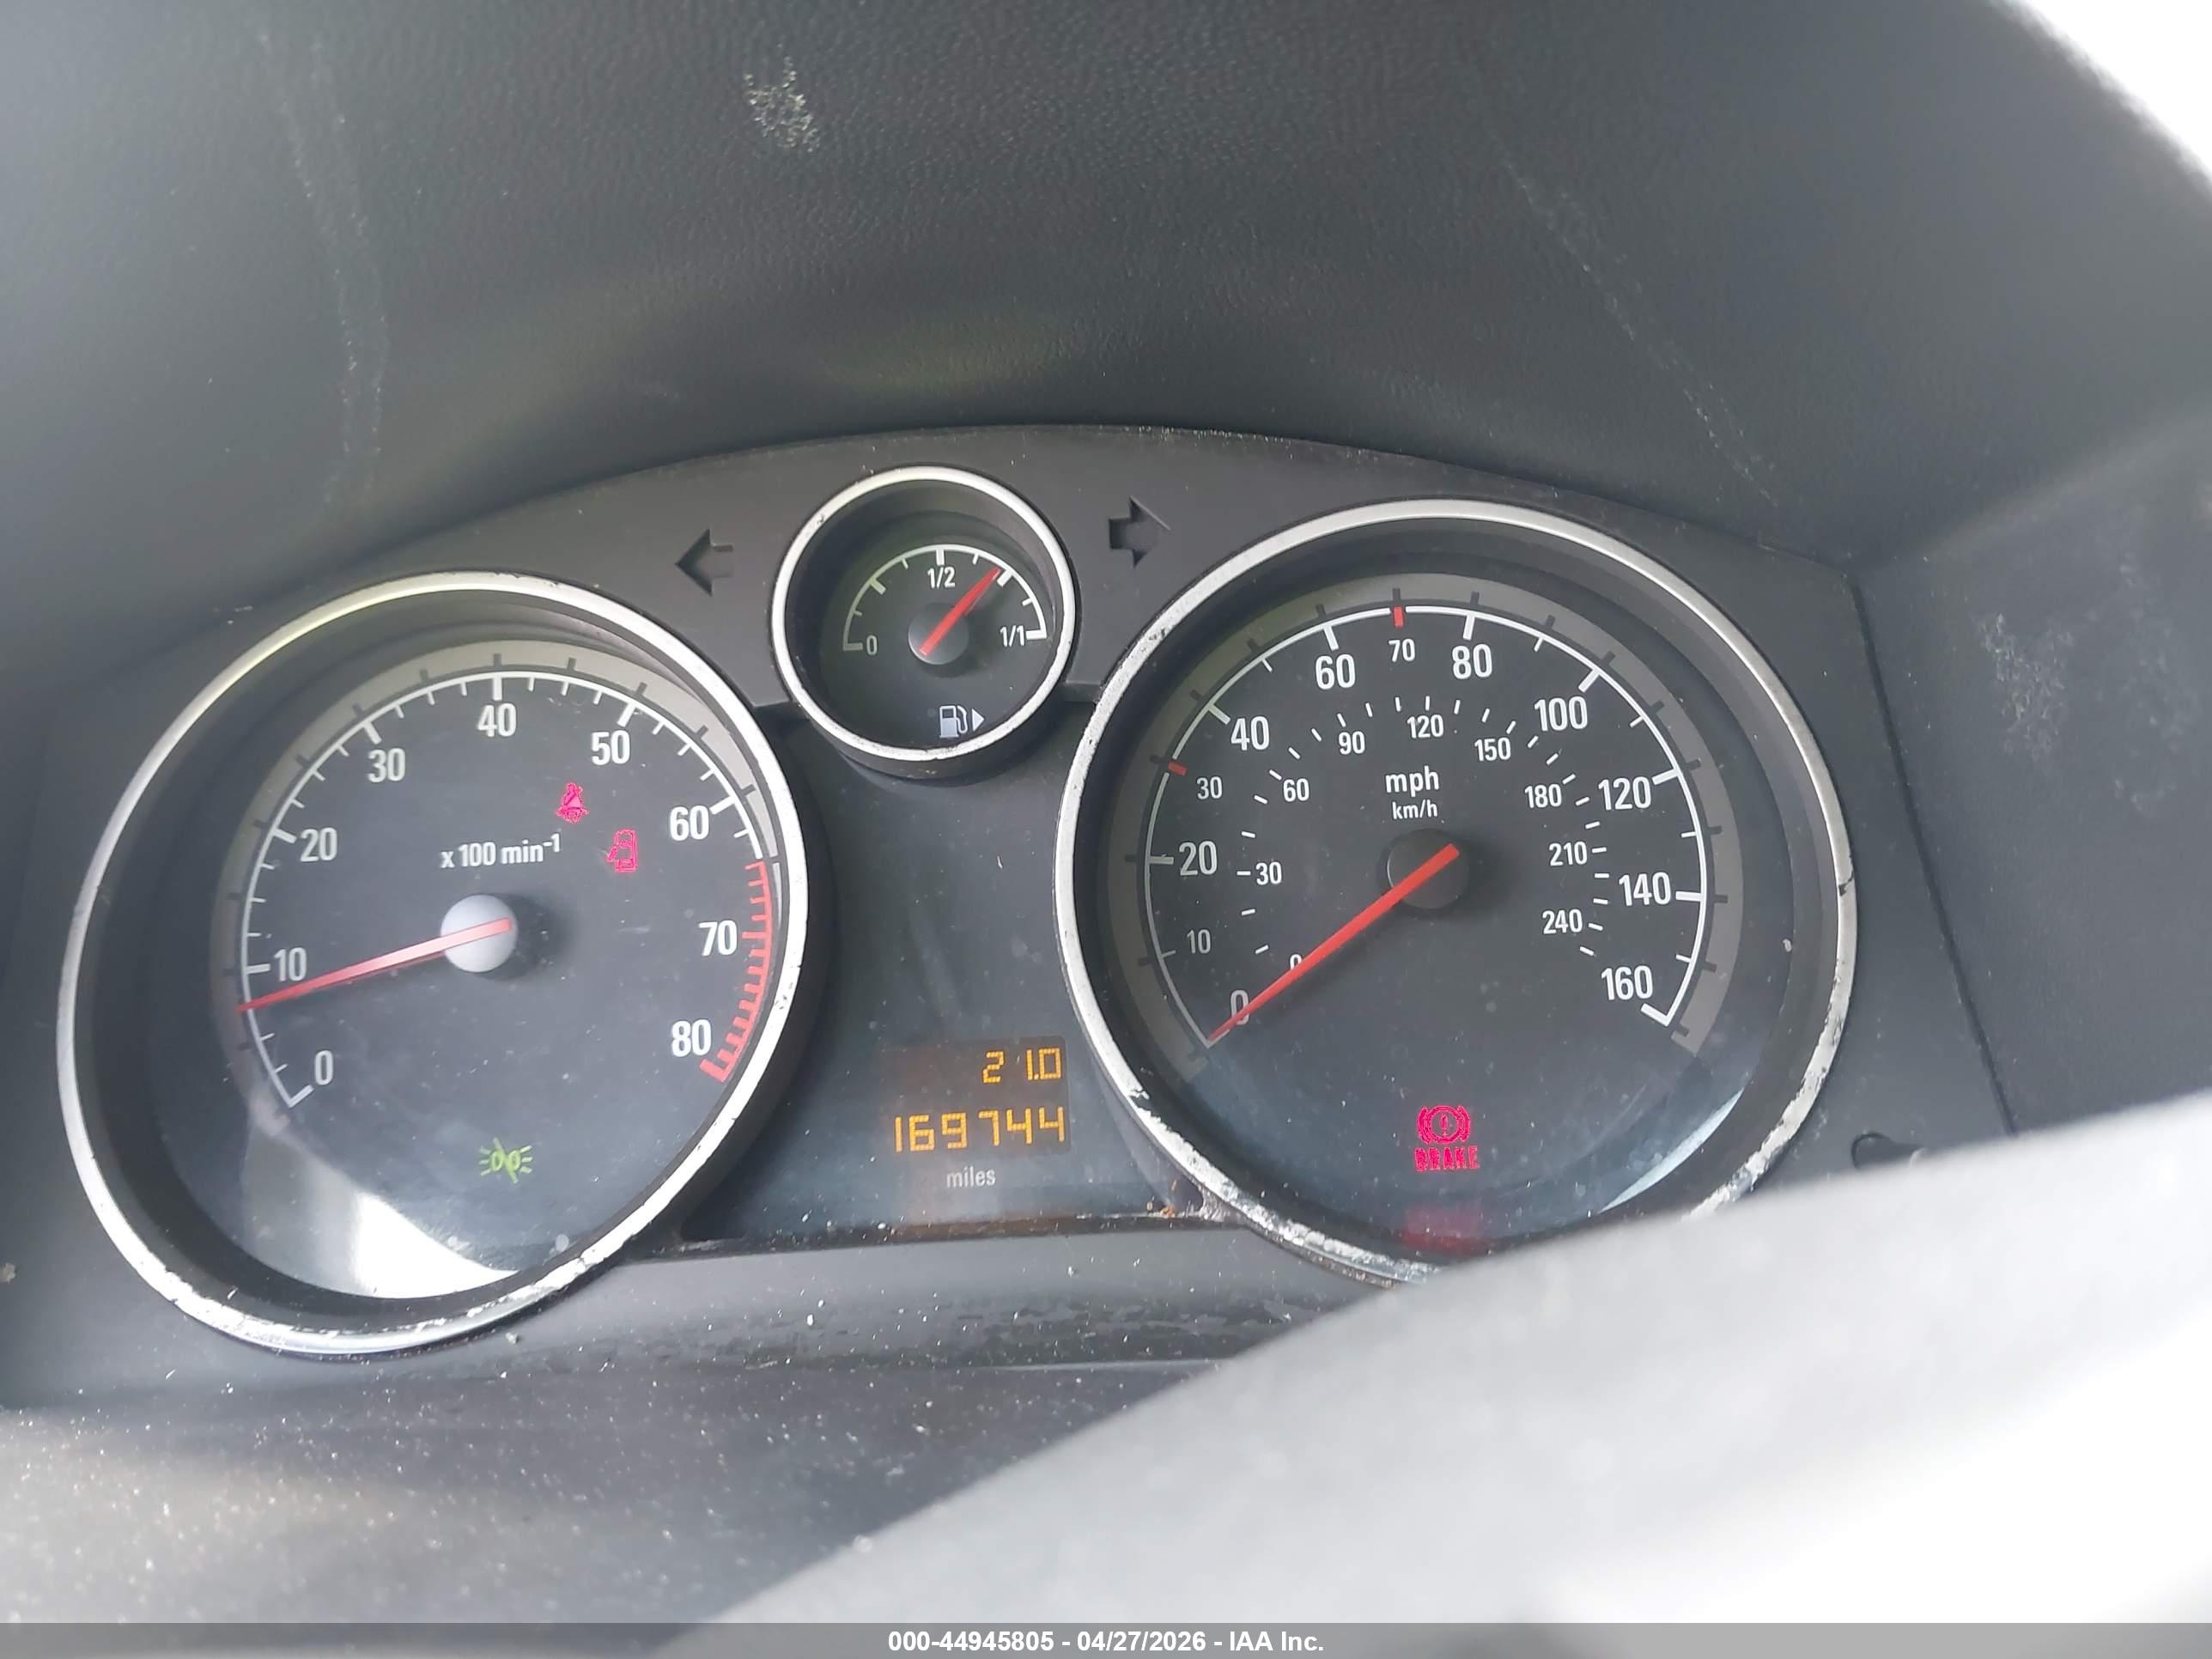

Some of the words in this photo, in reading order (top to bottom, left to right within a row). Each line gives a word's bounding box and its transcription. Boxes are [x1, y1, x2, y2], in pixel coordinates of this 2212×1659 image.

[927, 566, 956, 589] 1/2
[866, 635, 878, 655] 0
[1000, 624, 1025, 647] 1/1
[1388, 637, 1417, 663] 70
[1314, 653, 1357, 690] 60
[1450, 641, 1493, 680] 80
[477, 702, 517, 738] 40
[1406, 713, 1445, 740] 120
[1533, 694, 1589, 732] 100
[590, 729, 632, 766] 50
[1230, 714, 1271, 752] 40
[1337, 730, 1367, 756] 90
[1474, 735, 1513, 763] 150
[367, 746, 406, 783] 30
[1384, 763, 1441, 794] mph
[1195, 775, 1224, 800] 30
[1281, 777, 1311, 803] 60
[1523, 782, 1563, 810] 180
[1597, 774, 1653, 811] 120
[668, 804, 710, 842] 60
[1390, 799, 1439, 821] km/h
[299, 826, 338, 863] 20
[458, 841, 497, 868] 100
[1177, 840, 1218, 877] 20
[1547, 841, 1588, 867] 210
[1255, 860, 1283, 886] 30
[1618, 871, 1673, 907] 140
[698, 919, 738, 957] 70
[1541, 908, 1583, 935] 240
[1185, 928, 1212, 955] 10
[271, 945, 308, 982] 10
[1601, 963, 1654, 1003] 160
[1230, 989, 1250, 1025] 0
[670, 1018, 713, 1057] 80
[313, 1049, 334, 1086] 0
[894, 1106, 1065, 1152] 169744
[1414, 1145, 1480, 1173] BRAKE
[946, 1166, 996, 1188] miles
